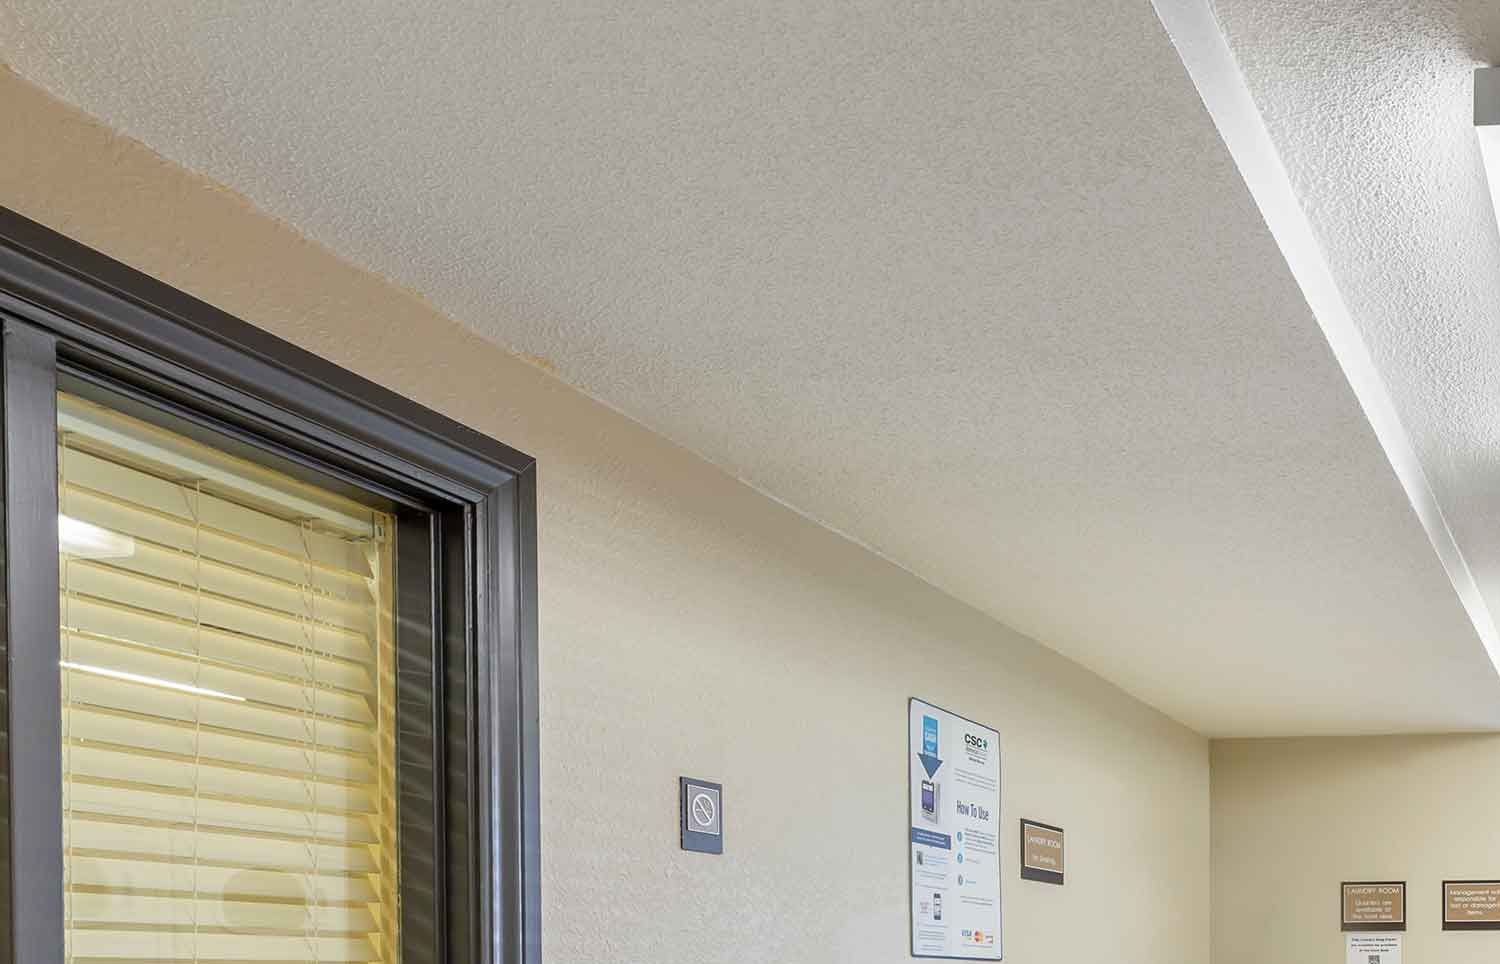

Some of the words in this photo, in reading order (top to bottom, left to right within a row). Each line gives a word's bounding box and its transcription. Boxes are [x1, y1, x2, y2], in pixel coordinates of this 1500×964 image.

[964, 733, 982, 748] CSC
[956, 799, 969, 816] How
[970, 803, 978, 818] To
[978, 804, 989, 821] Use
[1378, 887, 1400, 895] ROOM
